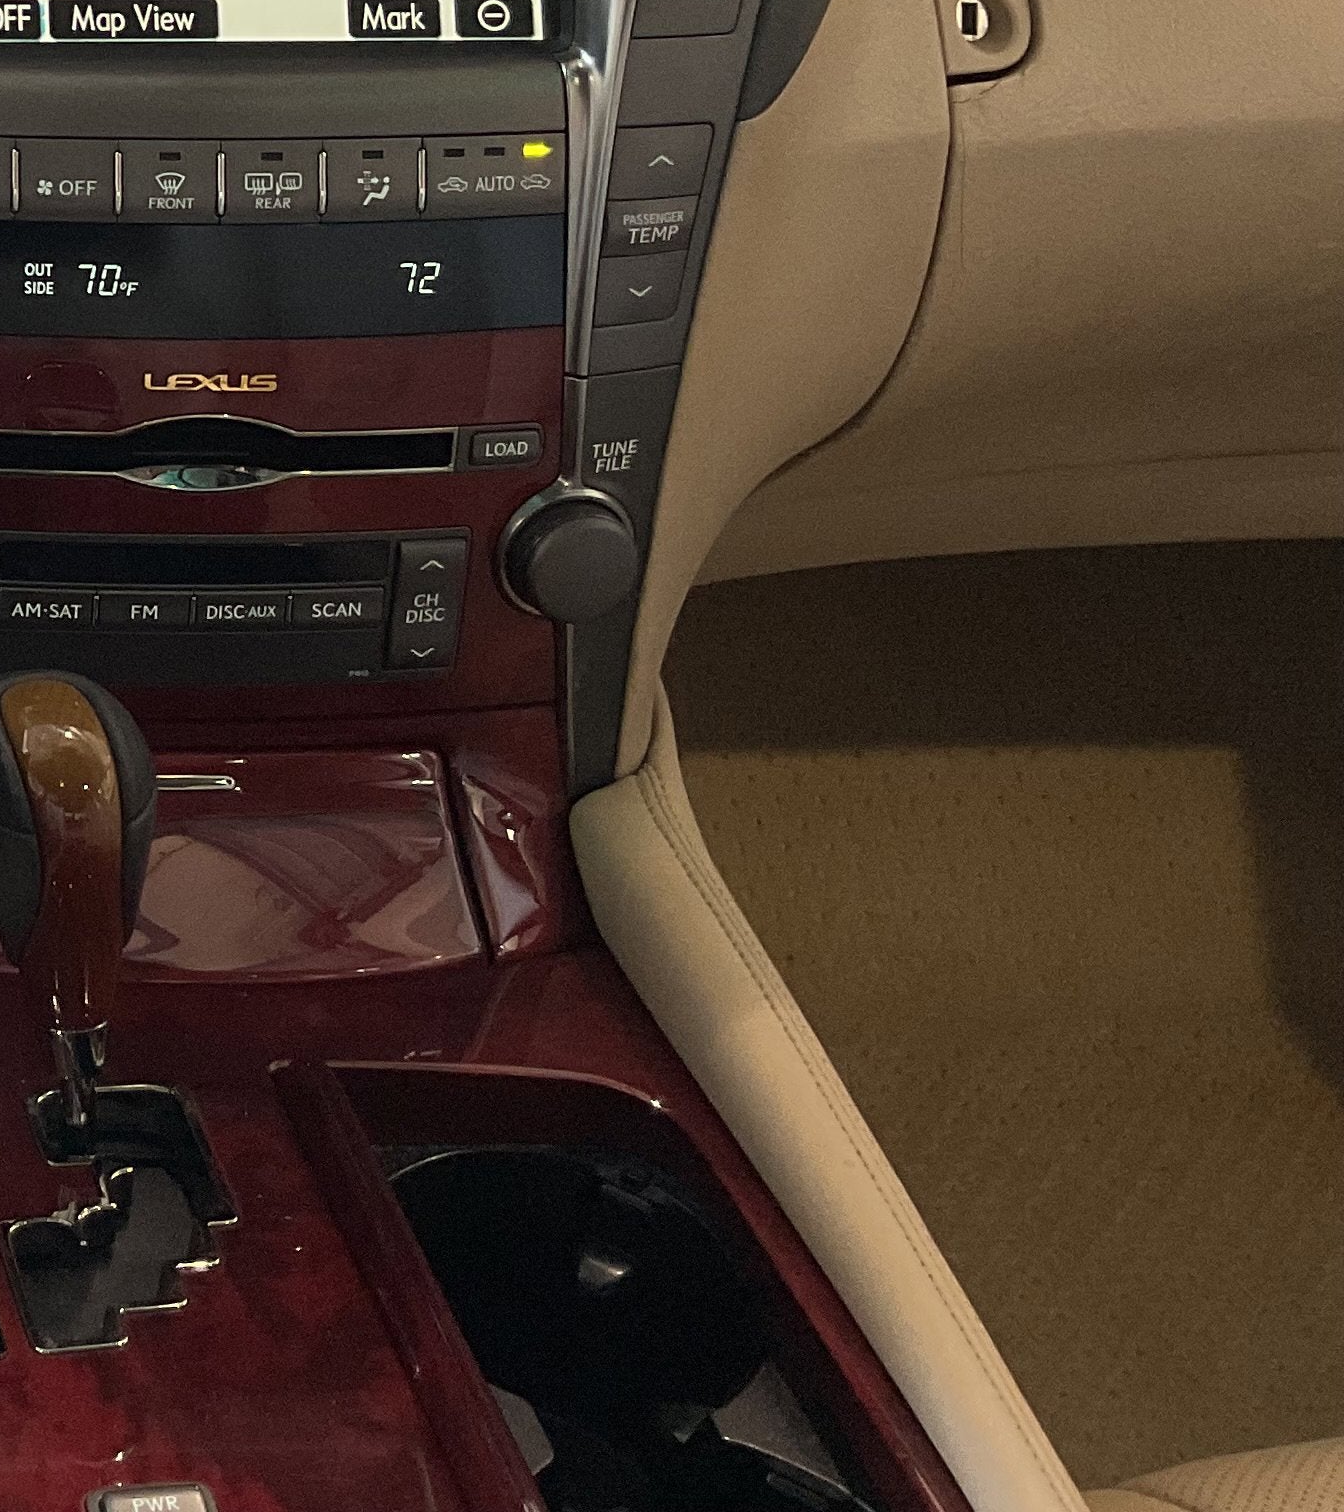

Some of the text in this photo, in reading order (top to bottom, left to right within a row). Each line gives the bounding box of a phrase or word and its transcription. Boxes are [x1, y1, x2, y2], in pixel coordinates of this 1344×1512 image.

[71, 3, 195, 38] Map View
[362, 2, 427, 31] Mark
[58, 179, 98, 197] OFF
[475, 175, 516, 192] AUTO
[147, 196, 195, 211] FRONT
[254, 197, 292, 210] REAR
[623, 210, 685, 226] PASSENGER
[627, 224, 680, 245] TEMP
[23, 262, 54, 277] OUT
[399, 262, 442, 295] 72
[23, 280, 55, 296] SIDE
[143, 373, 278, 392] LEXUS
[484, 440, 529, 458] LOAD
[592, 439, 639, 459] TUNE
[595, 456, 633, 474] FILE
[311, 601, 362, 618] SCAN
[413, 594, 439, 608] CH
[130, 604, 159, 621] FM
[405, 607, 446, 625] DISC
[131, 1495, 180, 1512] PWR
